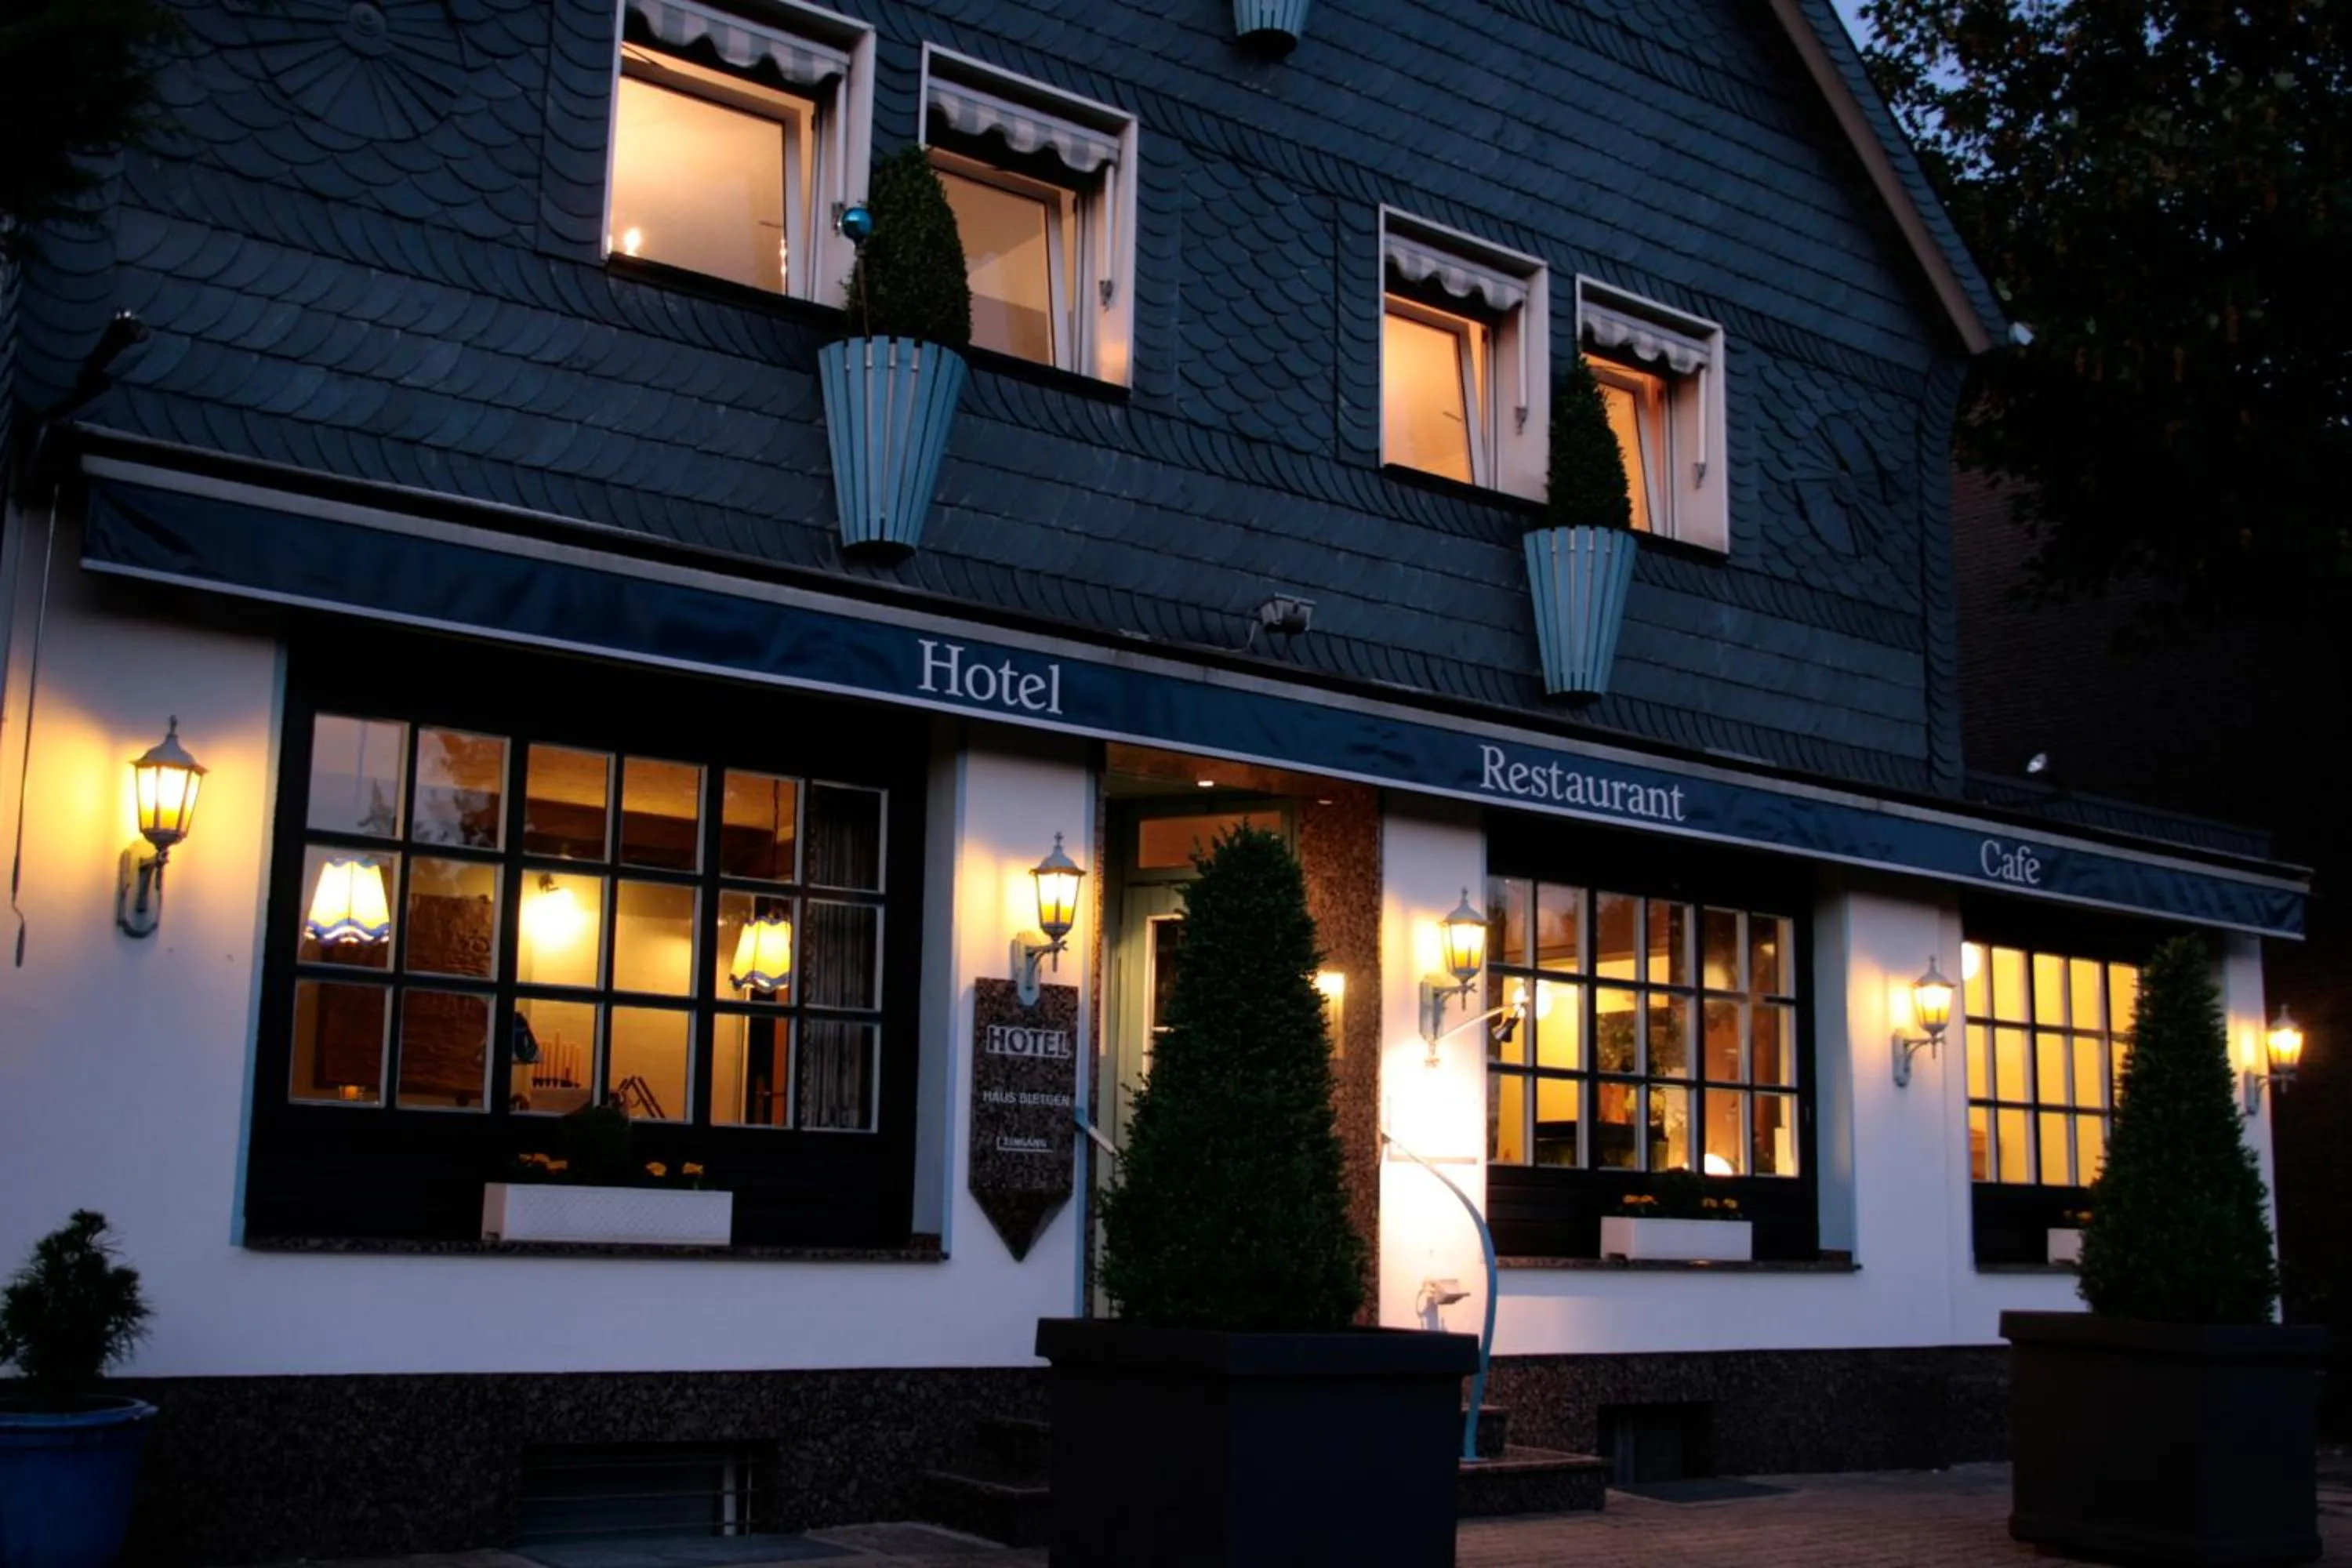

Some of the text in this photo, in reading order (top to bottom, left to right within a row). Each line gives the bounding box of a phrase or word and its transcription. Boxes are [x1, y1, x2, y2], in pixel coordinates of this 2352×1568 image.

[916, 638, 2041, 884] Hotel Restaurant Cafe
[987, 1025, 1069, 1058] HOTEL
[983, 1090, 1017, 1104] HAUS
